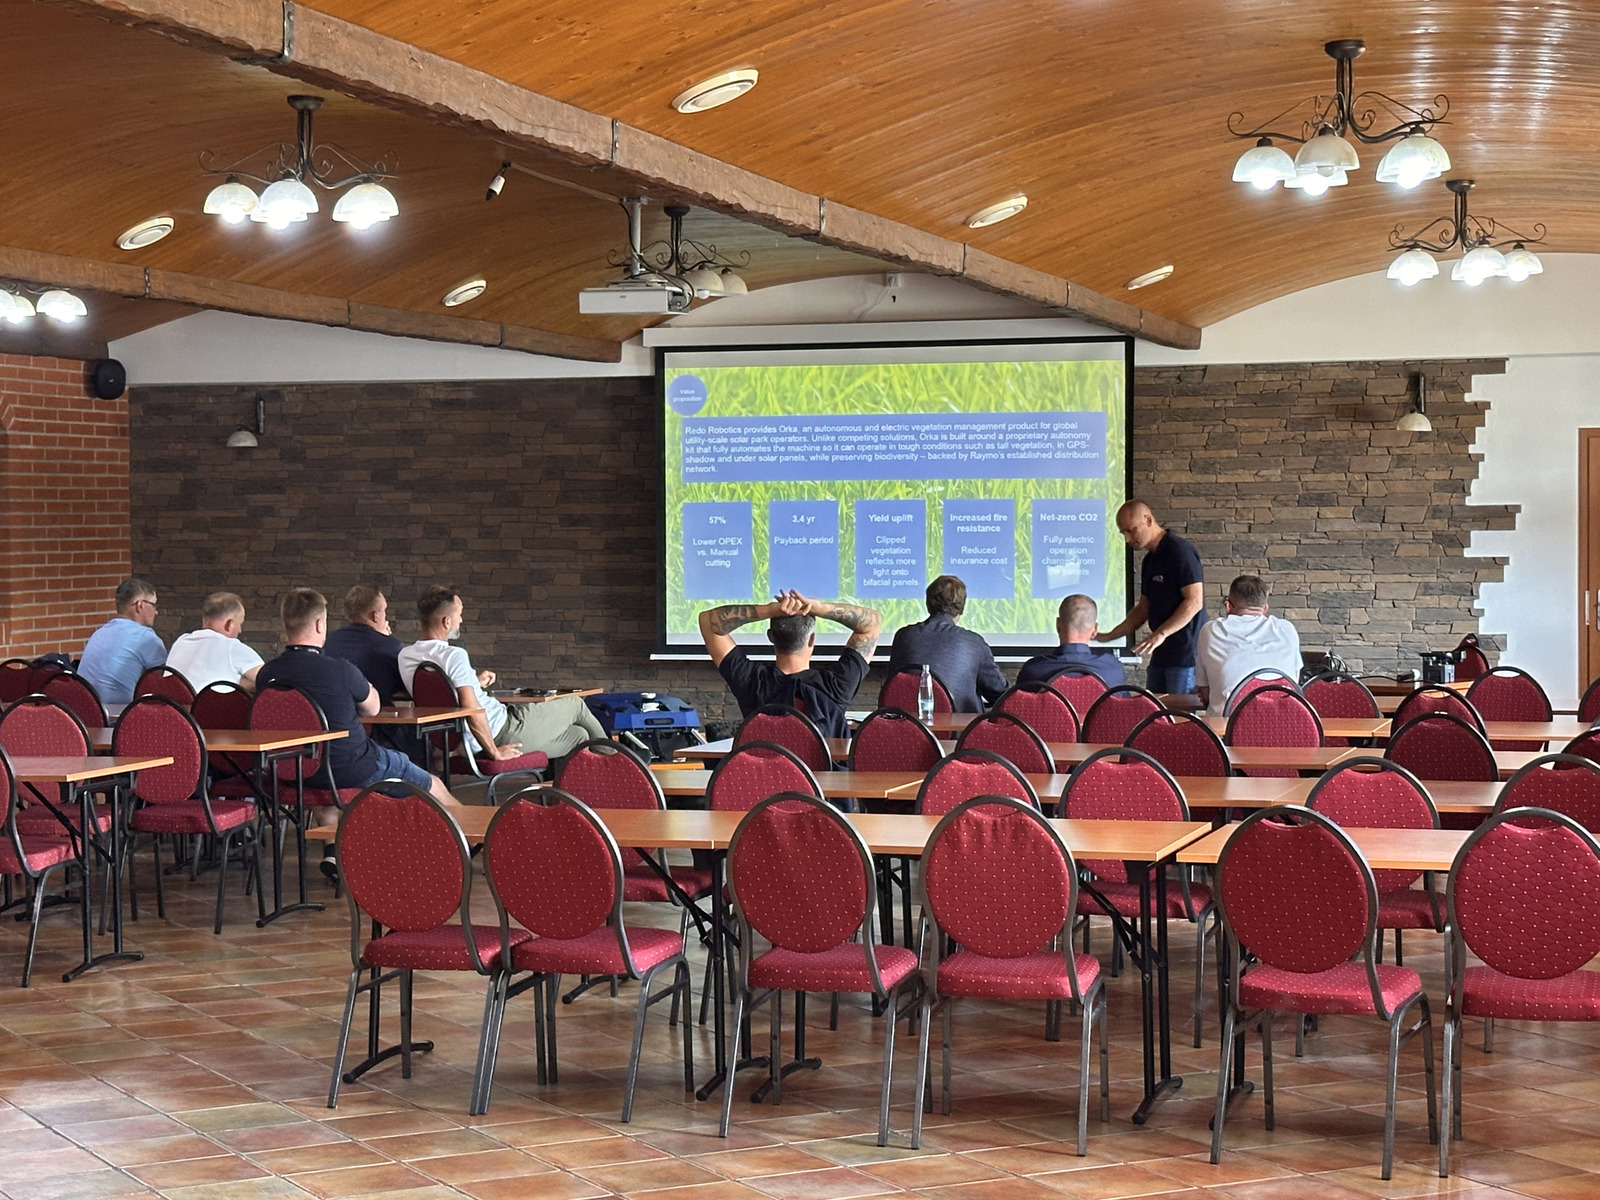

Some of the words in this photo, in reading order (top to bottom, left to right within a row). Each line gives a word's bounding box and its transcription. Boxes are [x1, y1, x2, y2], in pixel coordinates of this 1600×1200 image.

[708, 426, 742, 434] Robotics
[744, 426, 777, 437] provides
[778, 425, 800, 434] Orka,
[911, 424, 952, 434] vegetation
[954, 423, 1006, 432] management
[1008, 422, 1038, 431] product
[1053, 422, 1078, 431] global
[685, 436, 728, 446] utility-scale
[751, 436, 768, 445] park
[770, 436, 809, 445] operators.
[838, 434, 878, 443] competing
[880, 434, 917, 442] solutions,
[968, 432, 996, 440] around
[1006, 432, 1048, 442] proprietary
[1050, 432, 1091, 440] autonomy
[713, 446, 729, 455] fully
[730, 445, 771, 453] automates
[788, 444, 820, 452] machine
[857, 444, 886, 452] operate
[898, 443, 920, 452] tough
[922, 442, 962, 450] conditions
[964, 442, 983, 450] such
[1010, 442, 1054, 451] vegetation,
[1066, 441, 1090, 449] GPS-
[780, 454, 807, 464] panels,
[832, 454, 872, 462] preserving
[874, 453, 918, 462] biodiversity
[928, 452, 956, 460] backed
[958, 452, 968, 461] by
[970, 452, 1005, 461] Raymo's
[1054, 451, 1099, 459] distribution
[685, 465, 718, 473] network.
[708, 516, 726, 524] 57%
[806, 516, 816, 525] yr
[868, 514, 889, 522] Yield
[892, 514, 913, 524] uplift
[950, 513, 991, 522] Increased
[994, 513, 1008, 522] fire
[1040, 513, 1076, 522] Net-zero
[1078, 513, 1098, 522] CO2
[957, 524, 1000, 532] resistance
[692, 538, 716, 546] Lower
[718, 537, 742, 546] OPEX
[774, 536, 807, 546] Payback
[810, 536, 834, 546] period
[876, 536, 906, 545] Clipped
[1044, 536, 1062, 544] Fully
[1065, 535, 1094, 544] electric
[871, 546, 912, 556] vegetation
[961, 546, 996, 554] Reduced
[1050, 546, 1088, 556] operation
[705, 559, 730, 568] cutting
[866, 558, 894, 566] reflects
[951, 557, 988, 565] insurance
[1078, 558, 1095, 566] from
[873, 568, 890, 577] light
[864, 578, 890, 586] bifacial
[892, 578, 918, 588] panels
